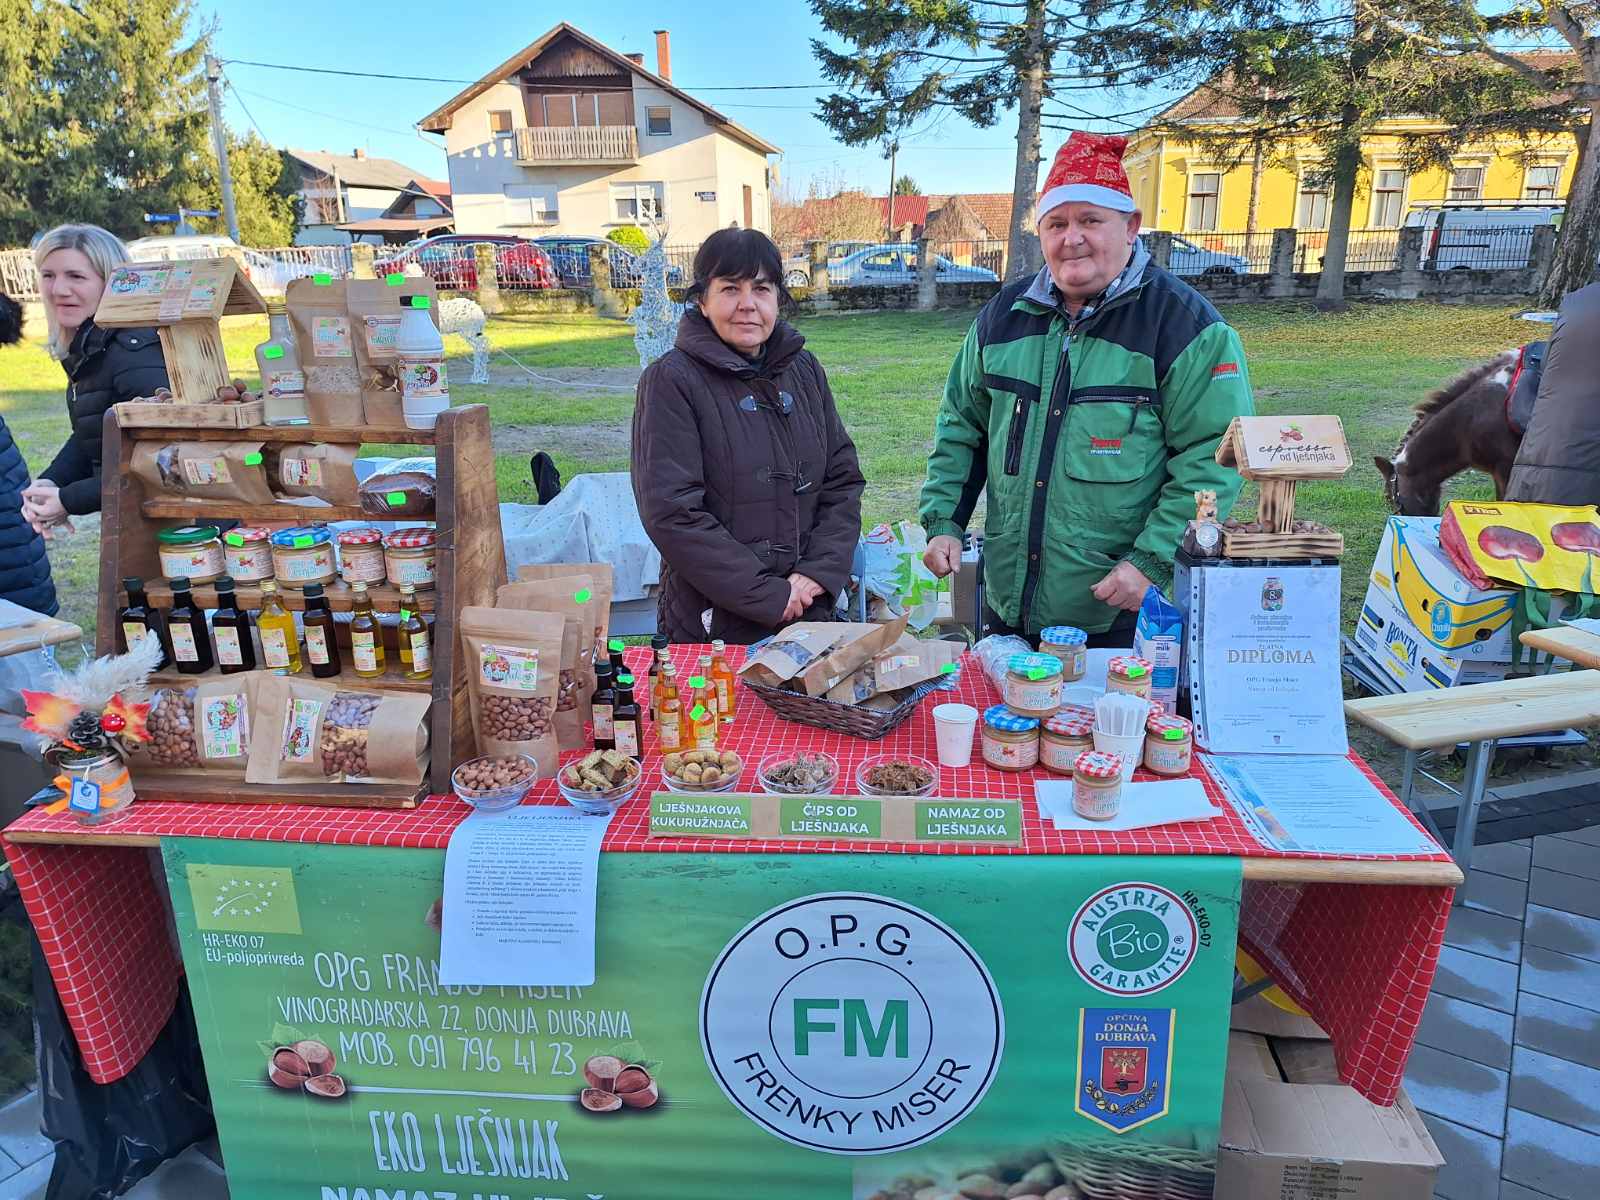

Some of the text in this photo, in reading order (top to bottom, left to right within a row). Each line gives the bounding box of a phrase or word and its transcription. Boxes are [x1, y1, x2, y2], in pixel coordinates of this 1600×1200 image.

[1258, 444, 1332, 462] espresso
[1280, 451, 1336, 465] od lješnjaka
[1385, 622, 1418, 666] BONITA
[1227, 649, 1316, 664] DIPLOMA
[659, 802, 742, 816] LJEŠNJAKOVA
[802, 803, 858, 817] ČIPS OD
[928, 807, 1006, 820] NAMAZ OD
[651, 814, 748, 830] KUKURUŽNJAČA
[790, 818, 869, 834] LJEŠNJAKA
[927, 821, 1007, 836] LJEŠNJAKA
[1082, 890, 1171, 931] AUSTRIA
[1182, 890, 1212, 948] HR-EKO-07
[202, 933, 264, 948] HR-EKO 07
[774, 913, 915, 966] O.P.G.
[1100, 923, 1162, 959] Bio
[206, 948, 305, 966] EU-poljoprivreda
[314, 951, 371, 992] OPG
[277, 996, 430, 1030] VINOGRADARSKA
[475, 1007, 540, 1035] DONJA
[549, 1009, 632, 1040] DUBRAVA
[792, 998, 910, 1059] FM
[1104, 1023, 1149, 1032] DONJA
[1095, 1032, 1157, 1042] DUBRAVA
[340, 1032, 577, 1076] MOB. 091 796 41 23
[733, 1051, 973, 1135] FRENKY MISER
[368, 1107, 569, 1182] EKO LJEŠNJAK
